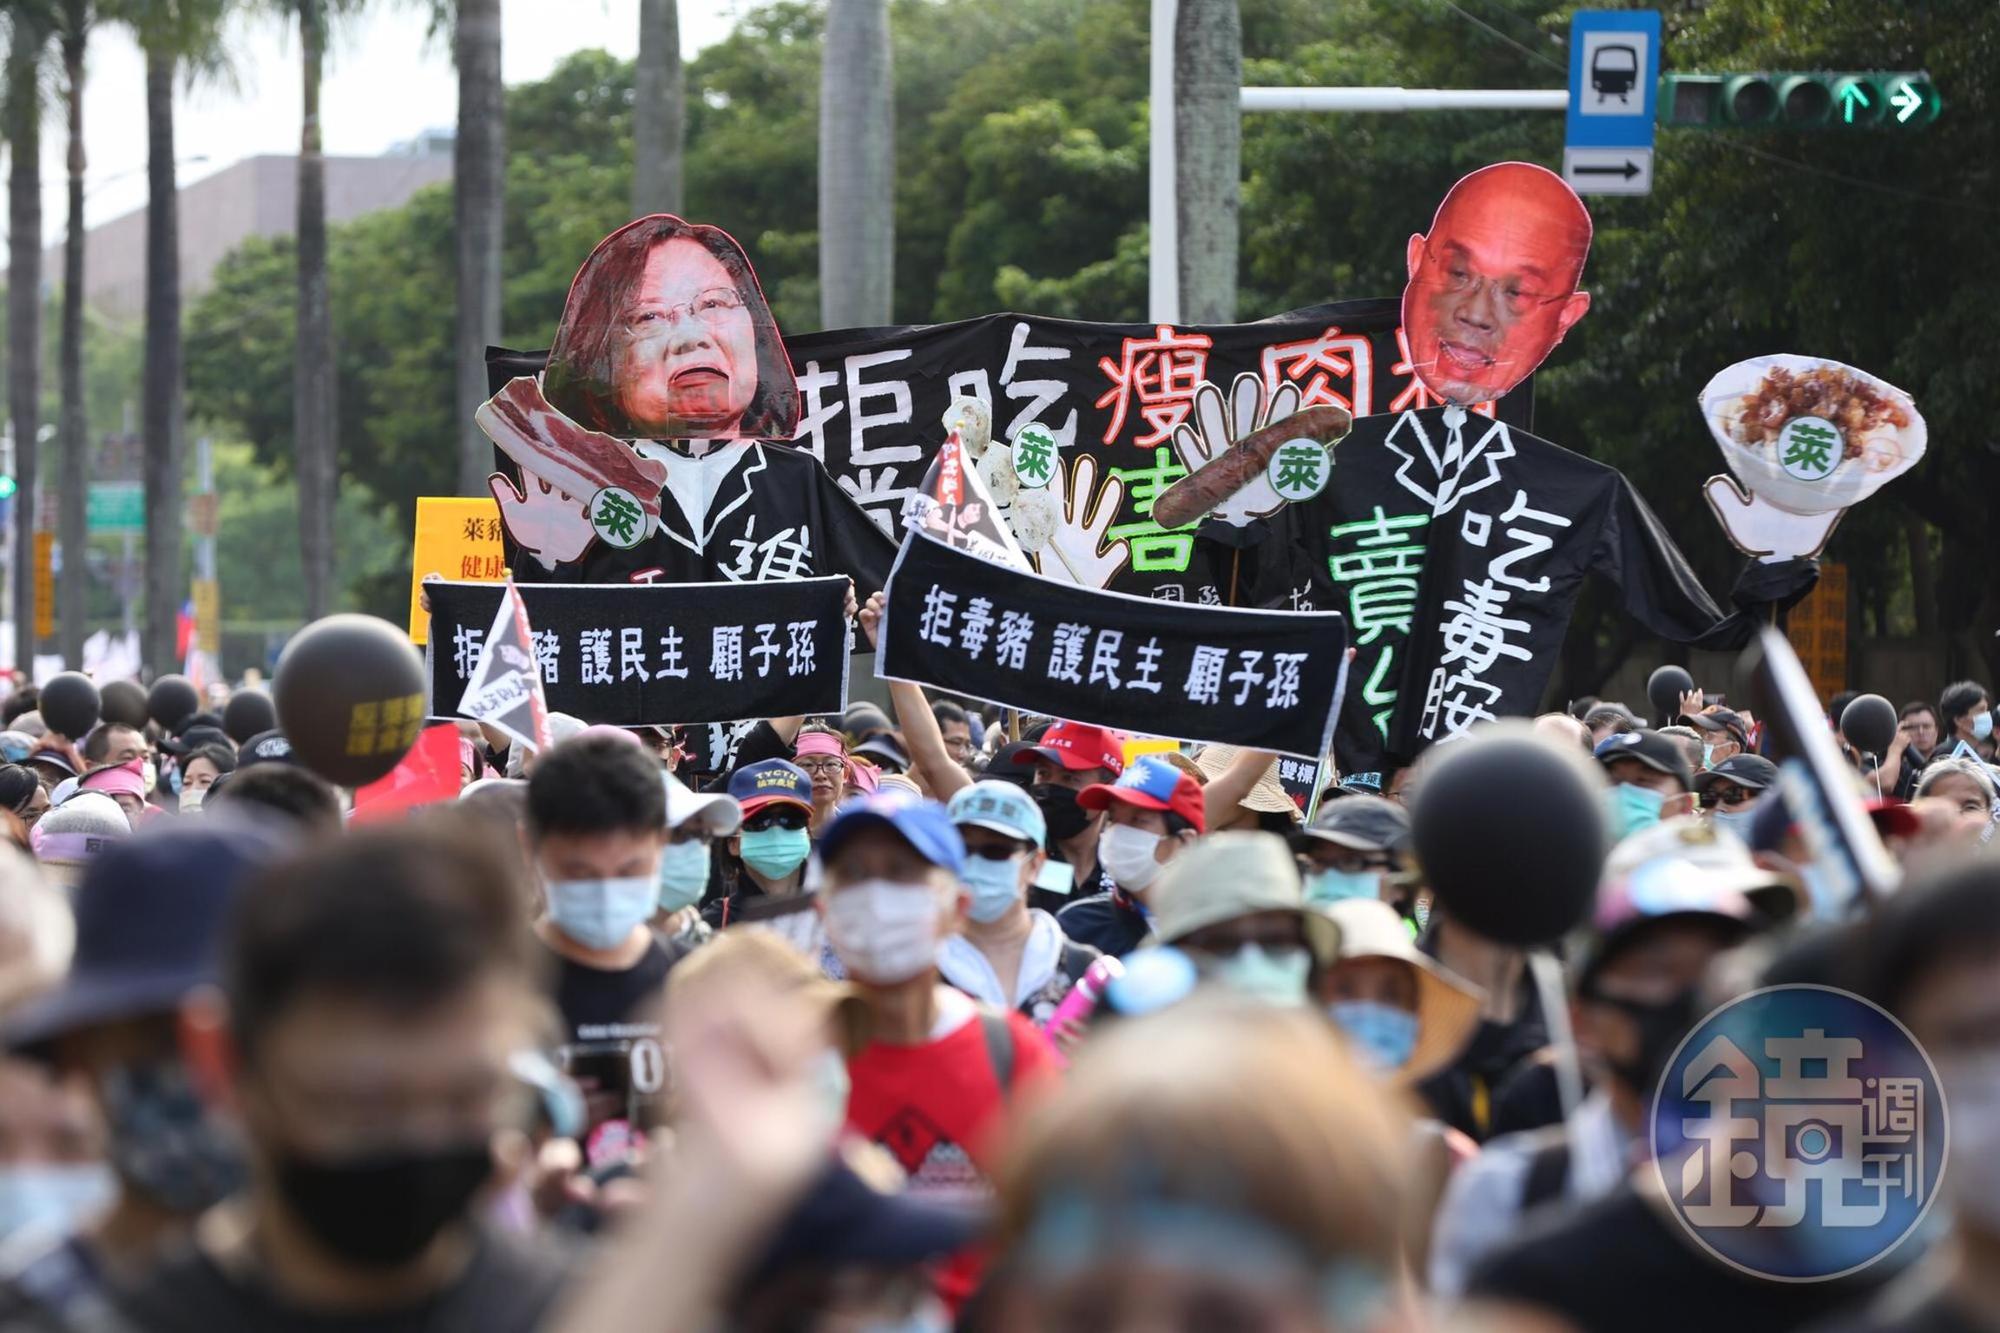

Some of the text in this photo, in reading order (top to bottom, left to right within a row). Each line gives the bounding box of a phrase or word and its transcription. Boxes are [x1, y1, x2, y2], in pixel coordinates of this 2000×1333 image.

[1015, 431, 1054, 479] 萊
[1276, 447, 1324, 492] 萊
[1784, 424, 1836, 474] 萊
[594, 487, 643, 545] 萊
[453, 624, 561, 684] 拒豬
[579, 625, 689, 685] 護民主
[709, 619, 819, 683] 顧子孫
[918, 583, 1035, 671] 拒毒豬
[1047, 622, 1164, 694] 護民主
[1184, 645, 1309, 710] 顧子孫
